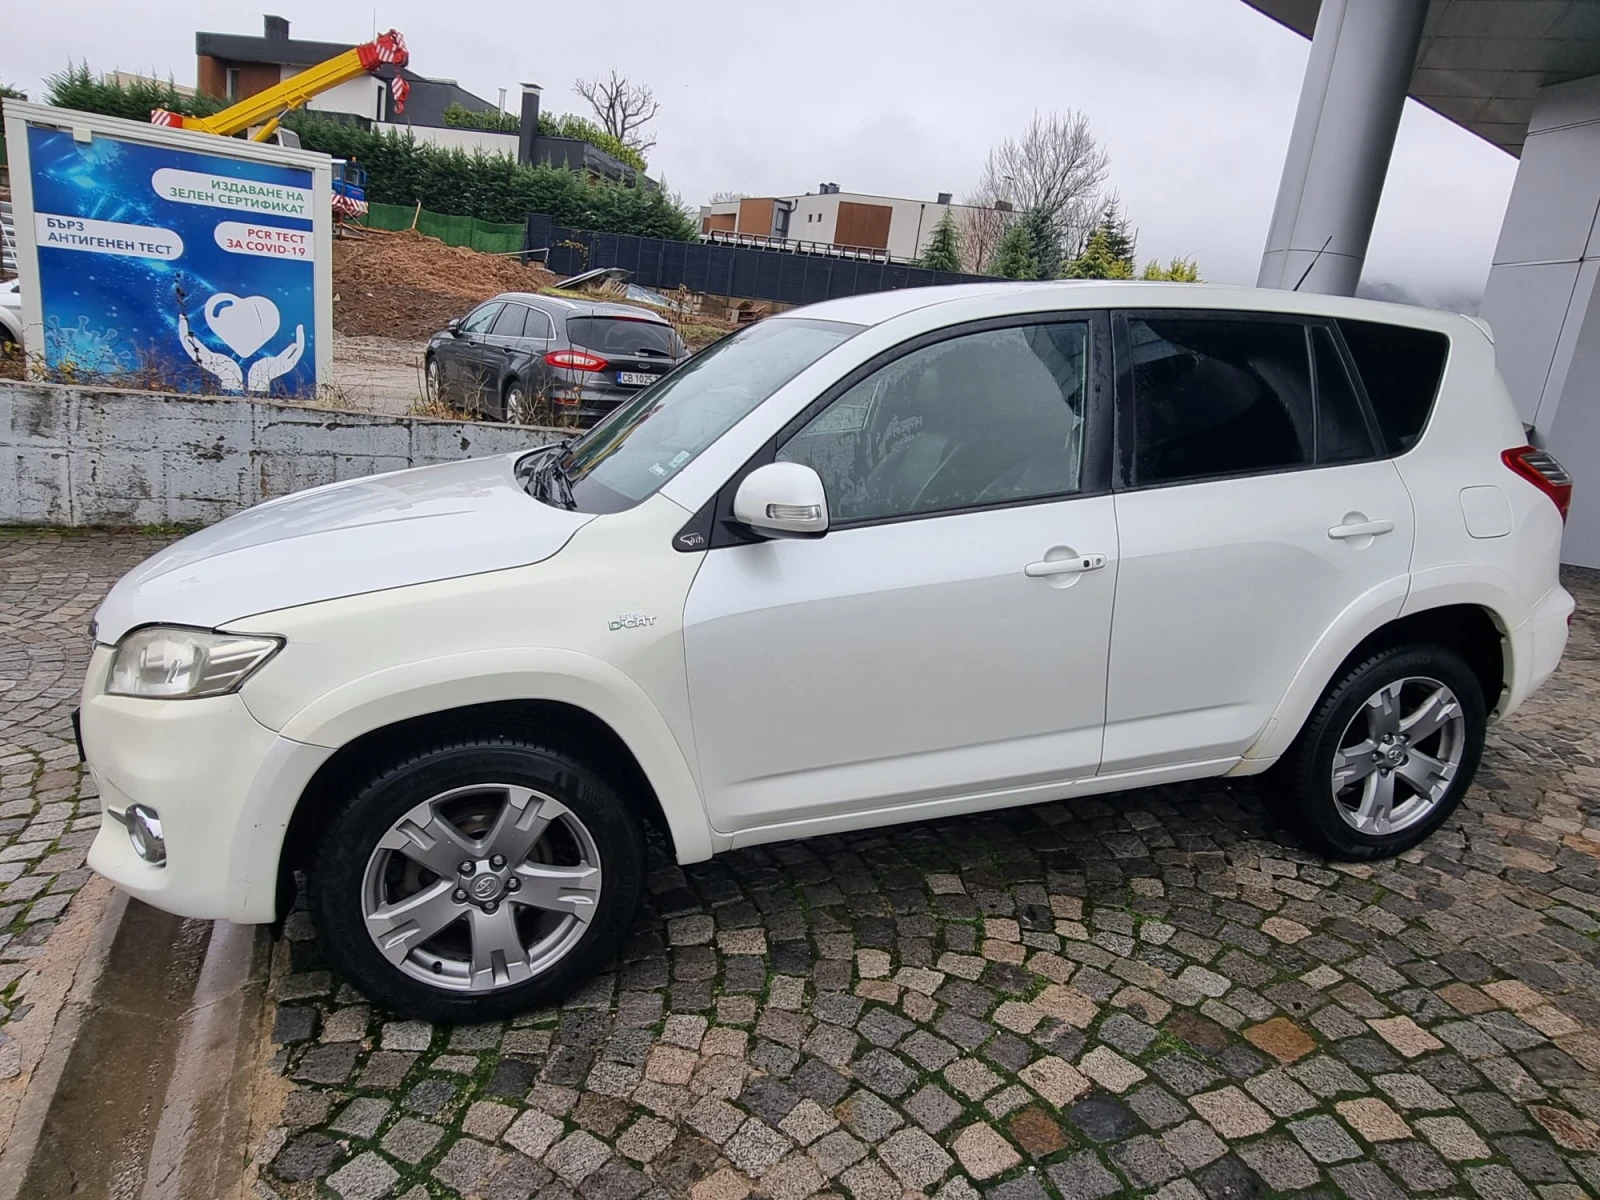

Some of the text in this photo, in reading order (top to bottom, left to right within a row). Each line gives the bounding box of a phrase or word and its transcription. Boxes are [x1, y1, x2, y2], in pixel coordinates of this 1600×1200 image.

[169, 187, 305, 214] ЗЕЛЕН СЕРТИФИКАТ
[211, 179, 304, 202] ИЗДАВАНЕ НА
[47, 217, 84, 232] БЪРЗ
[48, 232, 172, 255] АНТИГЕНЕН ТЕСТ
[247, 228, 305, 244] PCR ТЕСТ
[226, 238, 305, 257] ЗА COVID-19
